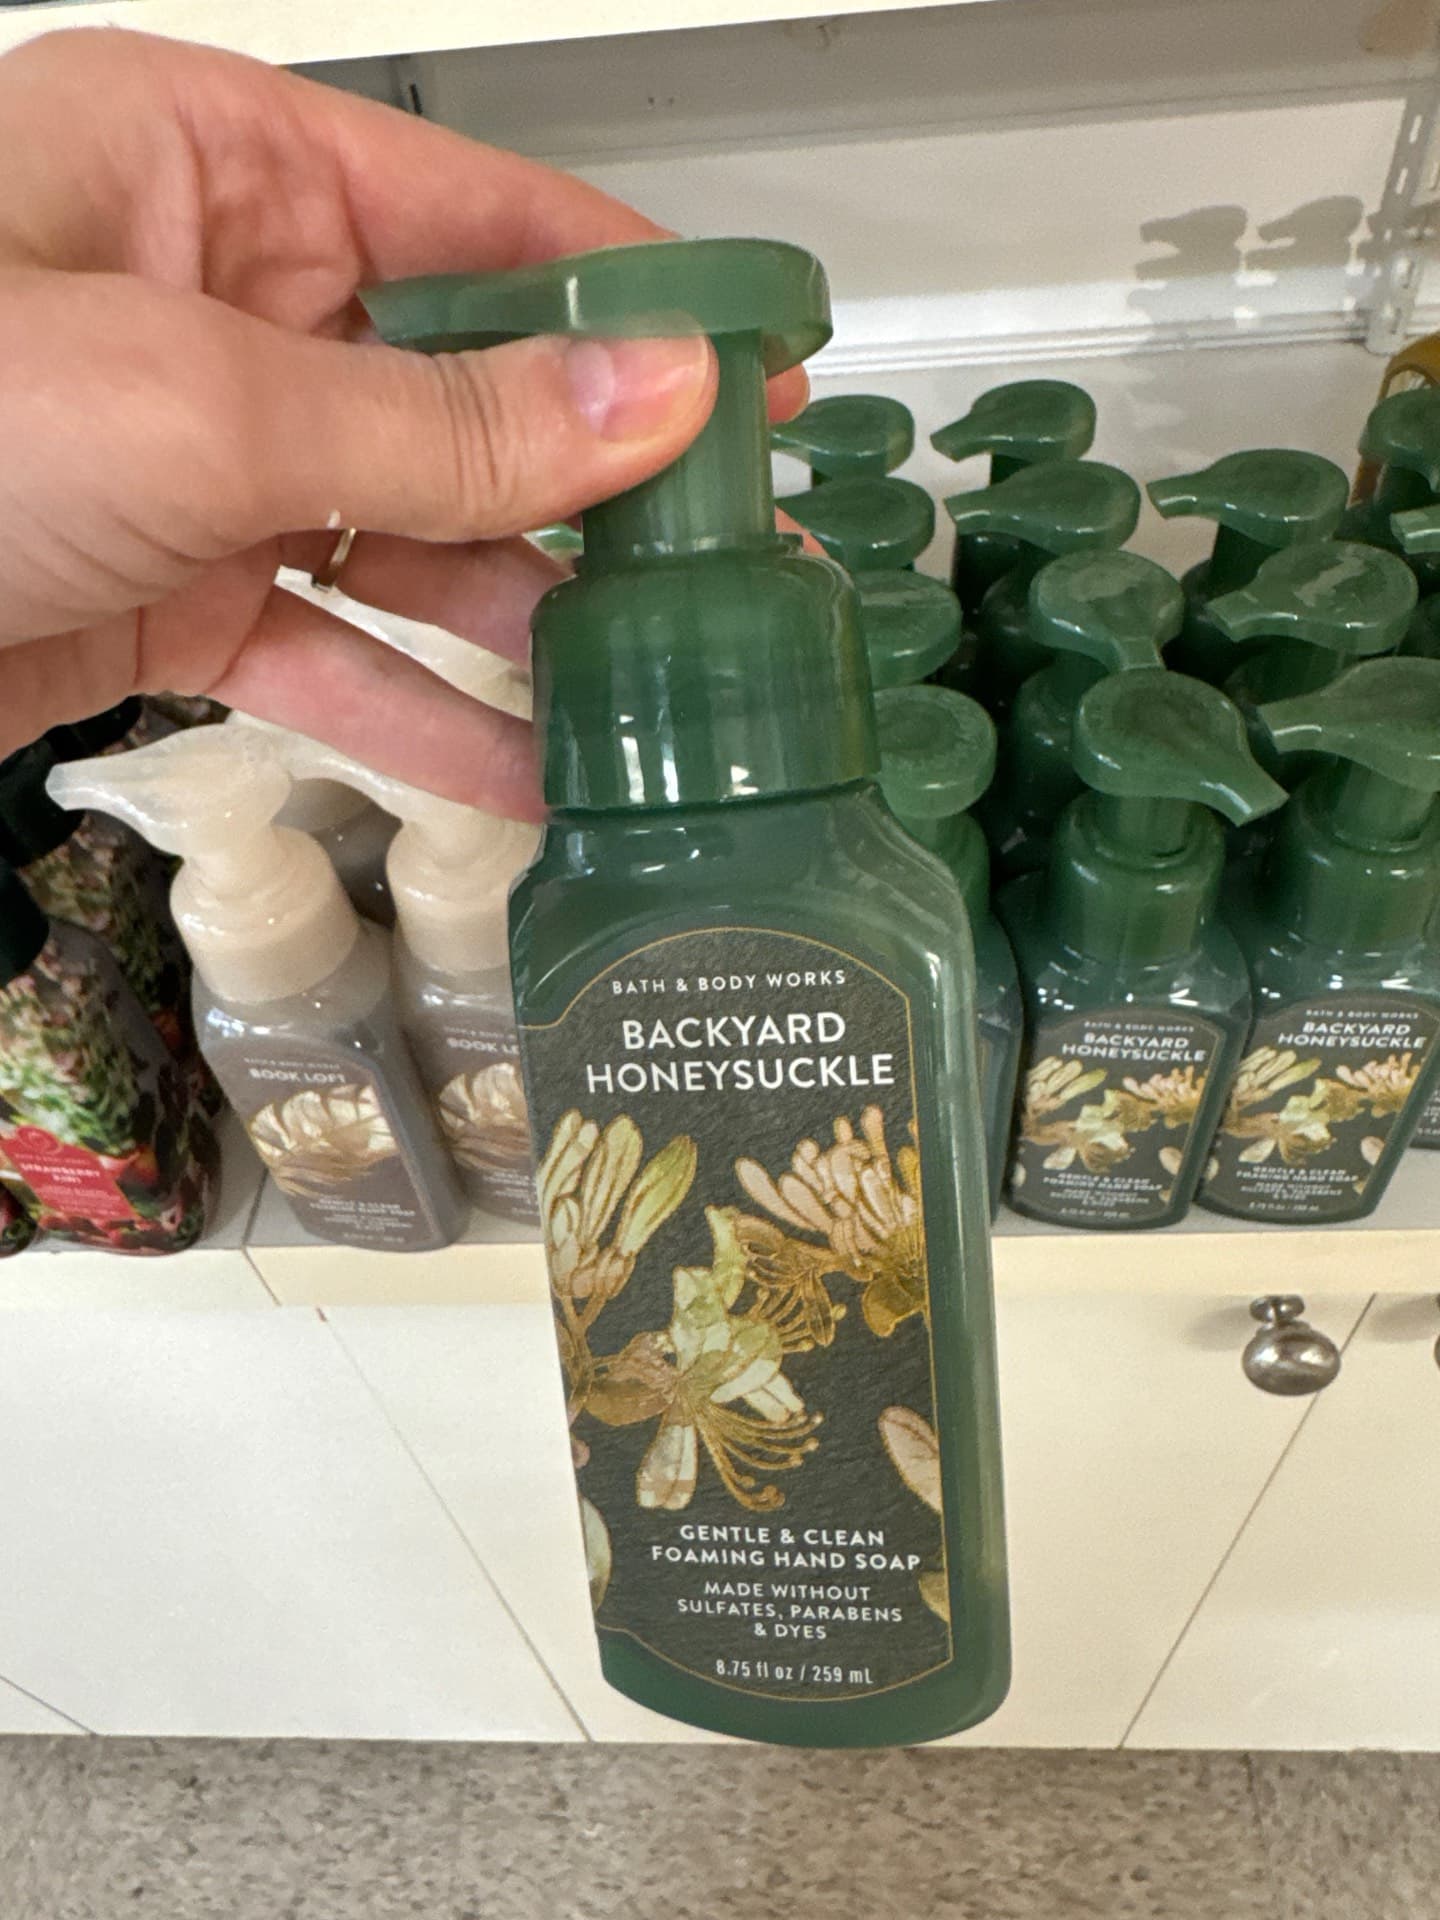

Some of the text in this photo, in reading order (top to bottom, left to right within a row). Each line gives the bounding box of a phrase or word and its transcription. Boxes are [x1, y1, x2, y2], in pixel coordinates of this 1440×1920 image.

[611, 970, 847, 995] BATH & BODY WORKS
[622, 1011, 846, 1050] BACKYARD
[1302, 1021, 1411, 1036] BACKYARD
[1083, 1031, 1189, 1049] BACKYARD
[1277, 1032, 1427, 1049] HONEYSUCKLE
[1061, 1043, 1207, 1062] HONEYSUCKLE
[248, 1067, 300, 1082] BOOK
[586, 1053, 896, 1094] HONEYSUCKLE
[680, 1524, 885, 1546] GENTLE & CLEAN
[651, 1545, 921, 1571] FOAMING HAND SOAP
[704, 1581, 871, 1601] MADE WITHOUT
[677, 1599, 902, 1622] SULFATES, PARABENS
[753, 1622, 827, 1640] & DYES
[715, 1659, 874, 1685] 8.75 fl oz / 259 mL
